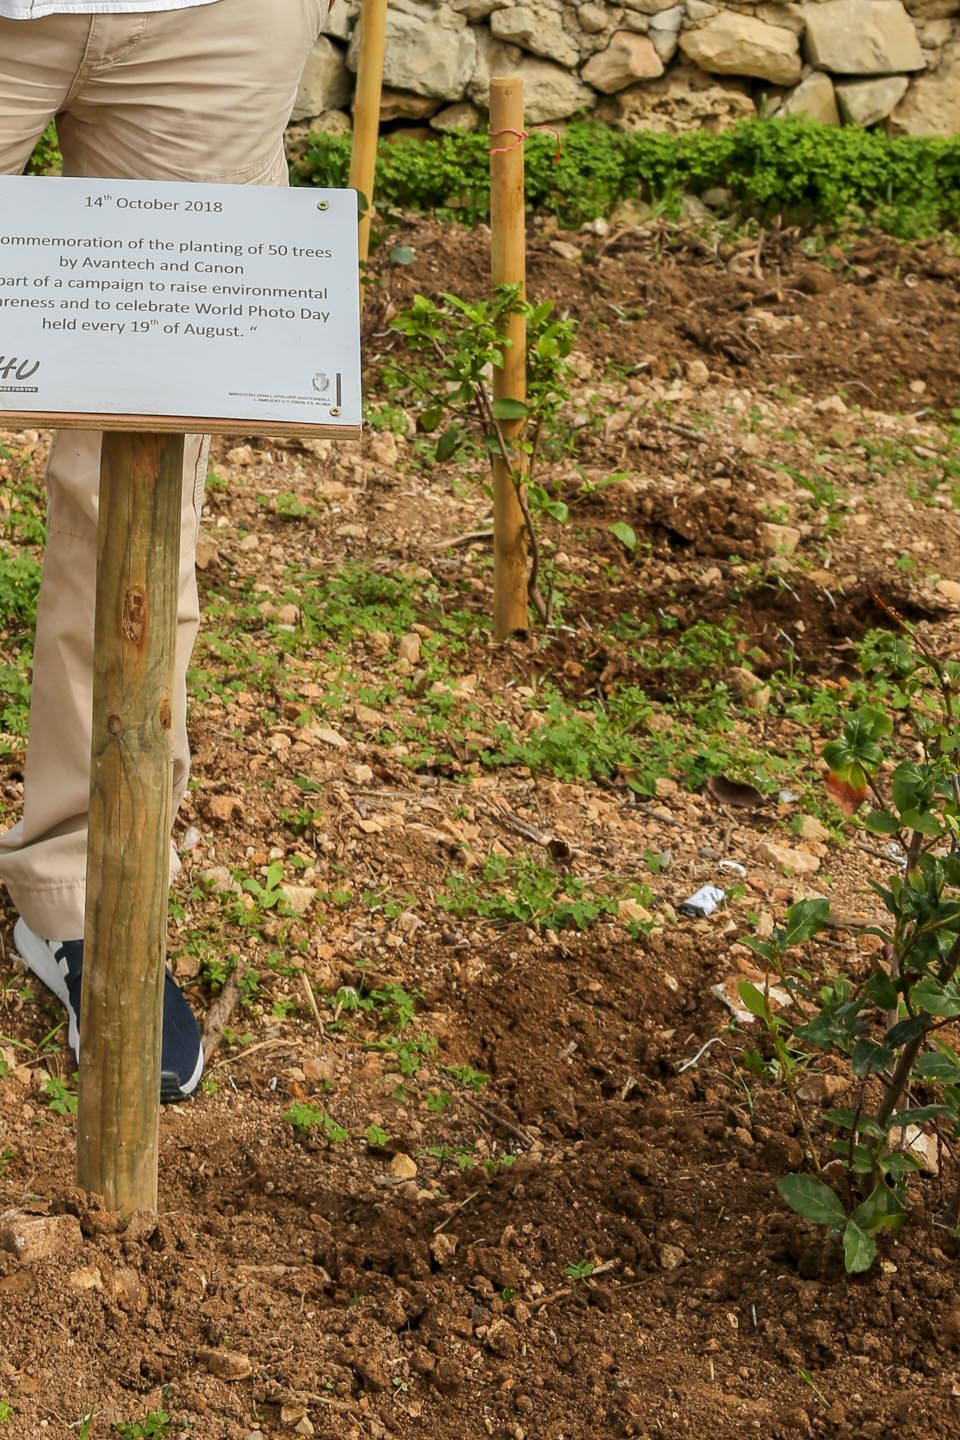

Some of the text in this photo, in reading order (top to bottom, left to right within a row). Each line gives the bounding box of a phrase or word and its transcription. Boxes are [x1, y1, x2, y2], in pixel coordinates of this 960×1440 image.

[117, 198, 179, 210] October
[184, 201, 222, 212] 2018
[128, 238, 144, 249] of
[148, 239, 174, 250] the
[180, 240, 243, 256] planting
[248, 244, 264, 254] of
[269, 245, 287, 256] 50
[292, 247, 332, 258] trees
[60, 256, 243, 274] by Avantech and Canon
[34, 276, 50, 287] of
[54, 279, 62, 287] a
[68, 279, 143, 292] campaign
[149, 281, 165, 291] to
[171, 284, 207, 293] raise
[212, 284, 327, 299] environmental
[60, 298, 89, 309] and
[94, 300, 110, 310] to
[116, 300, 189, 313] celebrate
[195, 303, 242, 315] World
[249, 305, 295, 318] Photo
[301, 308, 330, 323] Day
[43, 317, 76, 330] held
[82, 322, 125, 334] every
[163, 322, 180, 334] of
[184, 324, 243, 338] August.
